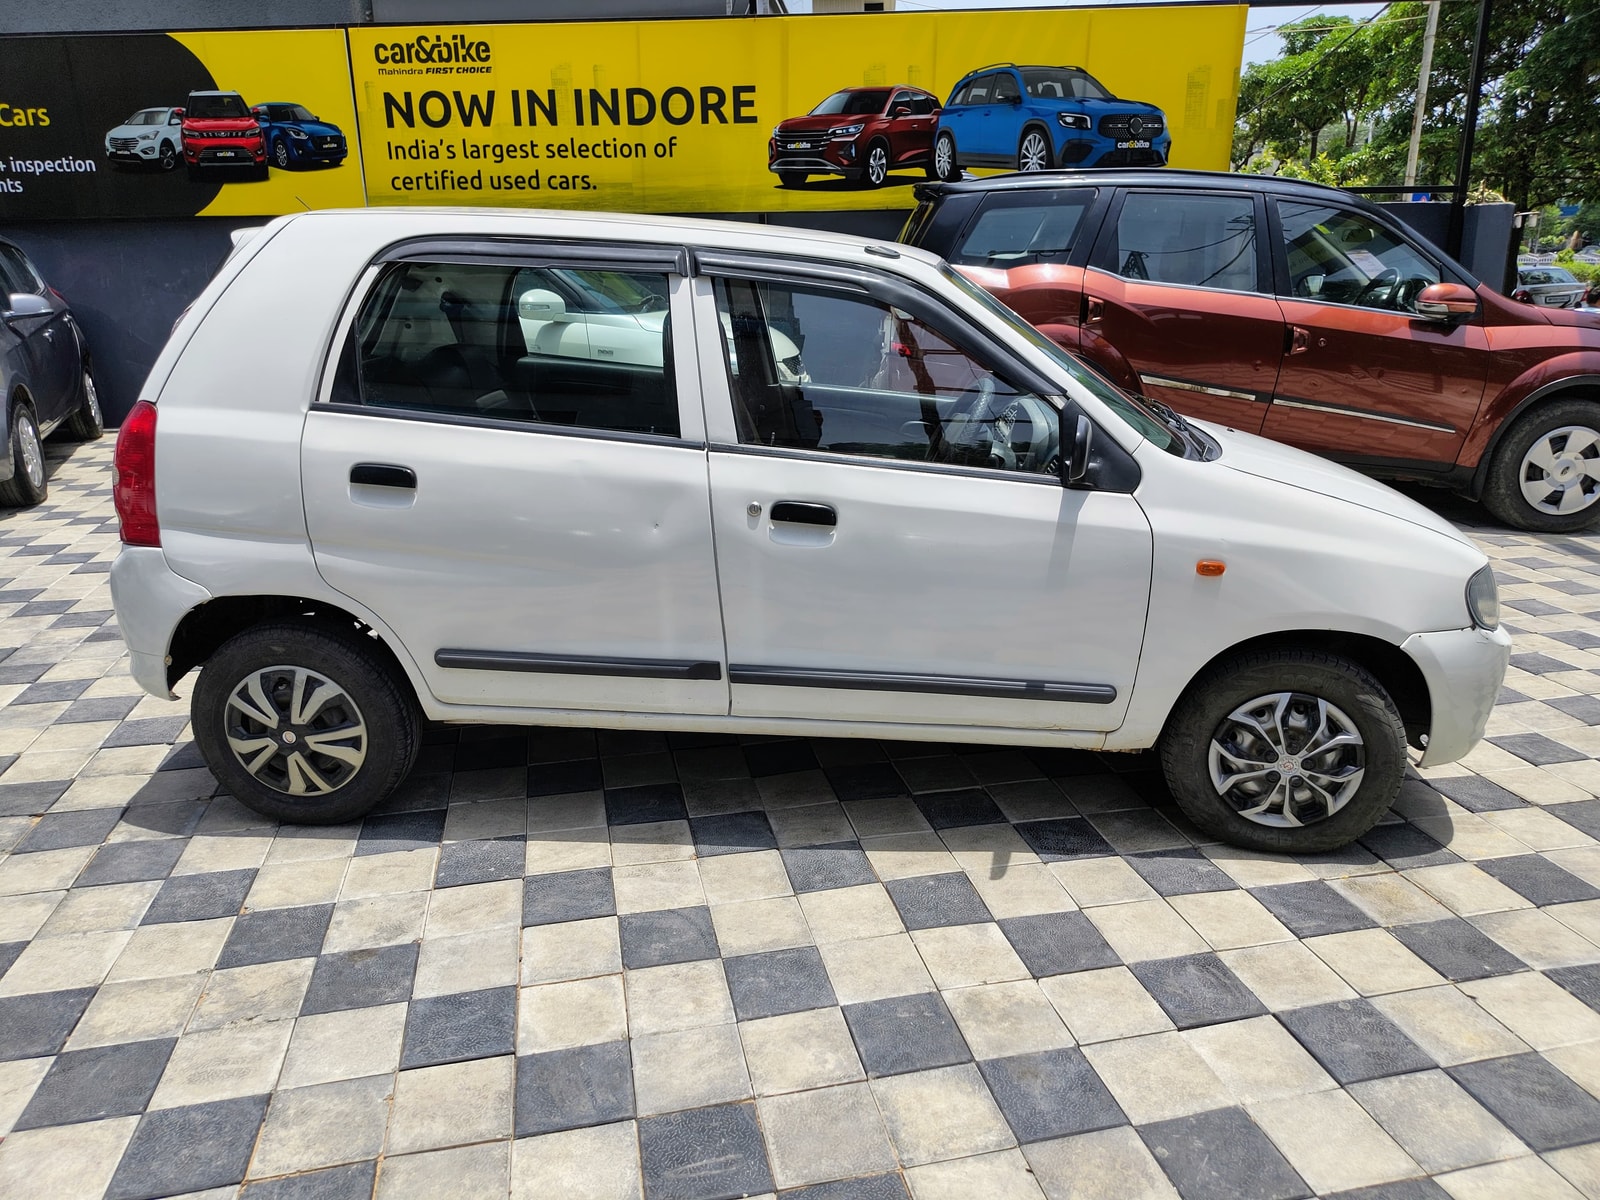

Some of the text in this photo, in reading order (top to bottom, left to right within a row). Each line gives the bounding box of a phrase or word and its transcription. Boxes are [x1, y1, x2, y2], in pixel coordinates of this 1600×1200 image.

[374, 34, 491, 64] car&bike
[425, 66, 454, 74] FIRST
[456, 66, 493, 74] CHOICE
[0, 103, 50, 127] Cars
[383, 85, 758, 128] NOW IN INDORE
[387, 136, 678, 163] India's largest selection of
[9, 156, 97, 176] inspection
[391, 169, 597, 191] certified used cars.
